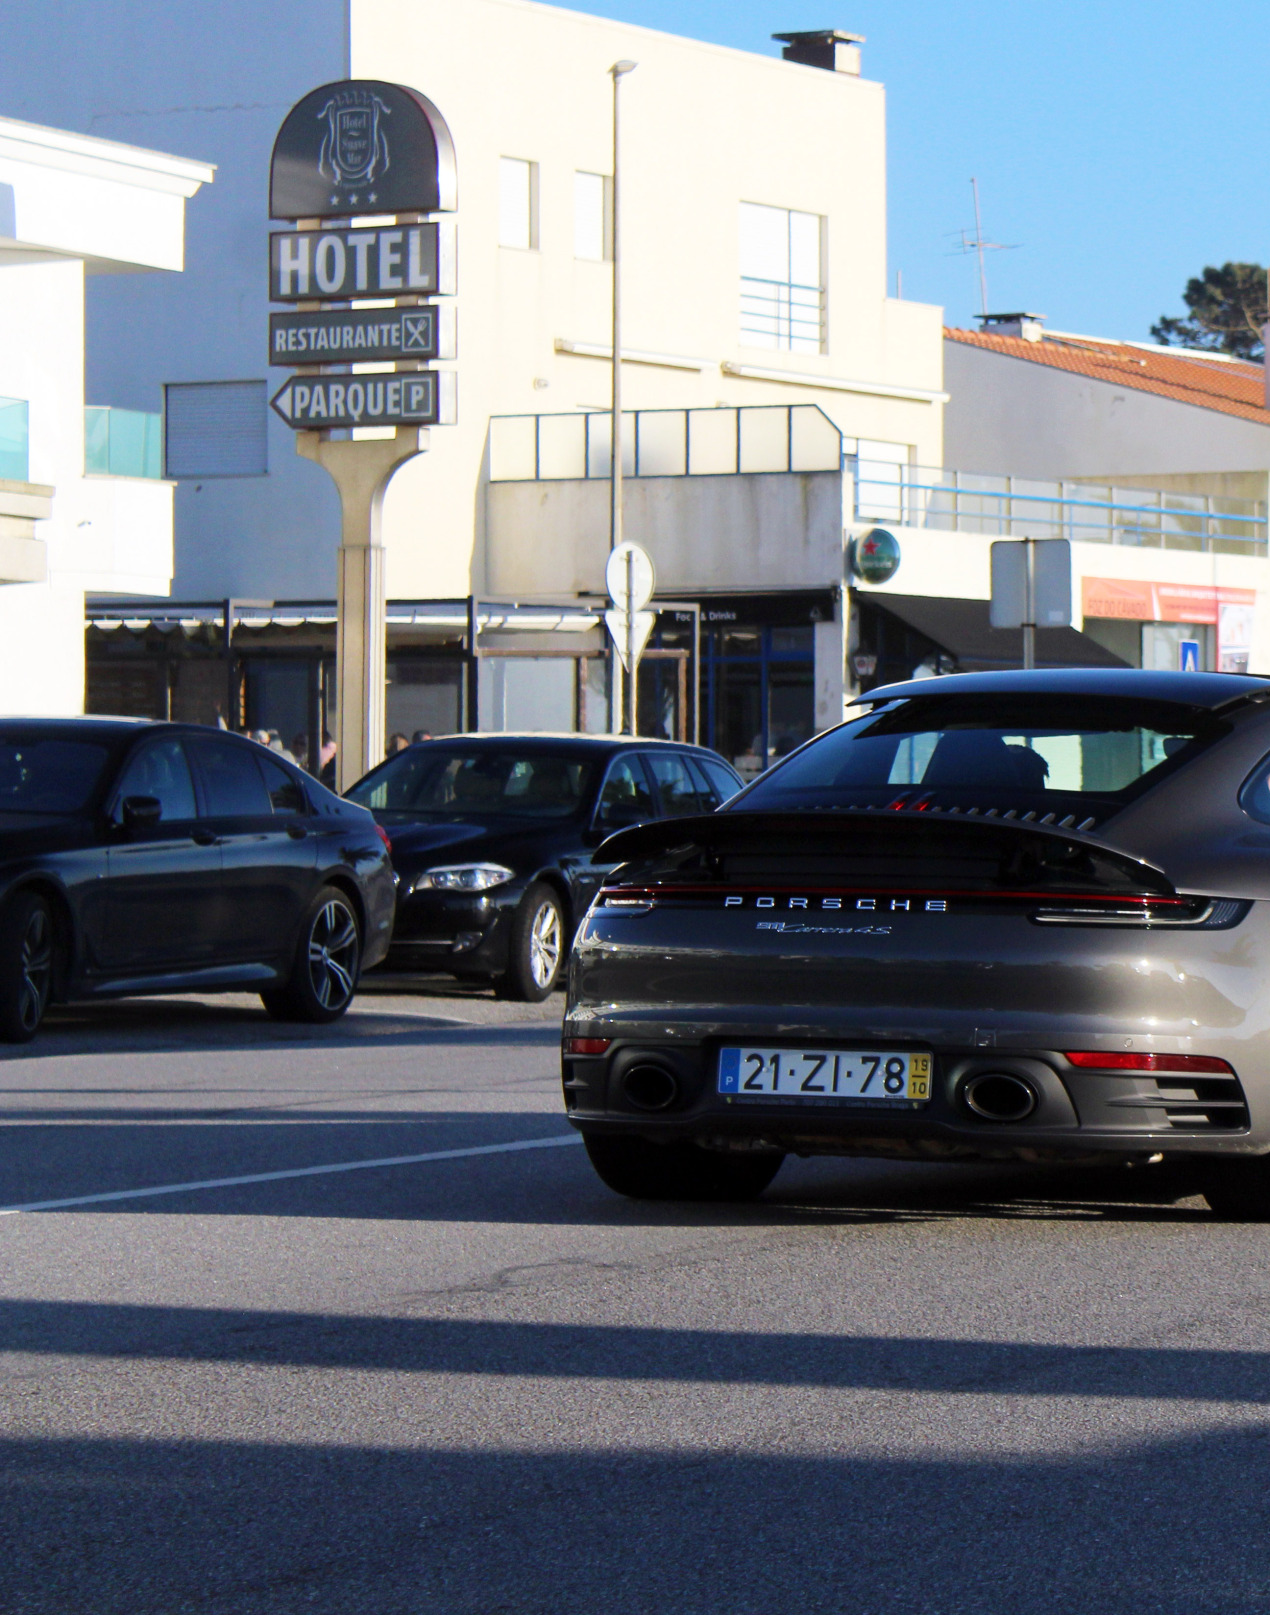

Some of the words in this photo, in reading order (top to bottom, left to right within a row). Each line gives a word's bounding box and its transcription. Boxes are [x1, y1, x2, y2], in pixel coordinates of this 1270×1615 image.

[342, 113, 367, 129] Hotel
[279, 229, 430, 296] HOTEL
[275, 323, 401, 352] RESTAURANTE
[294, 382, 401, 422] PARQUE
[709, 610, 736, 621] Drinks
[725, 896, 947, 911] PORSCHE
[913, 1058, 928, 1072] 19
[725, 1076, 734, 1086] P
[911, 1081, 927, 1095] 10
